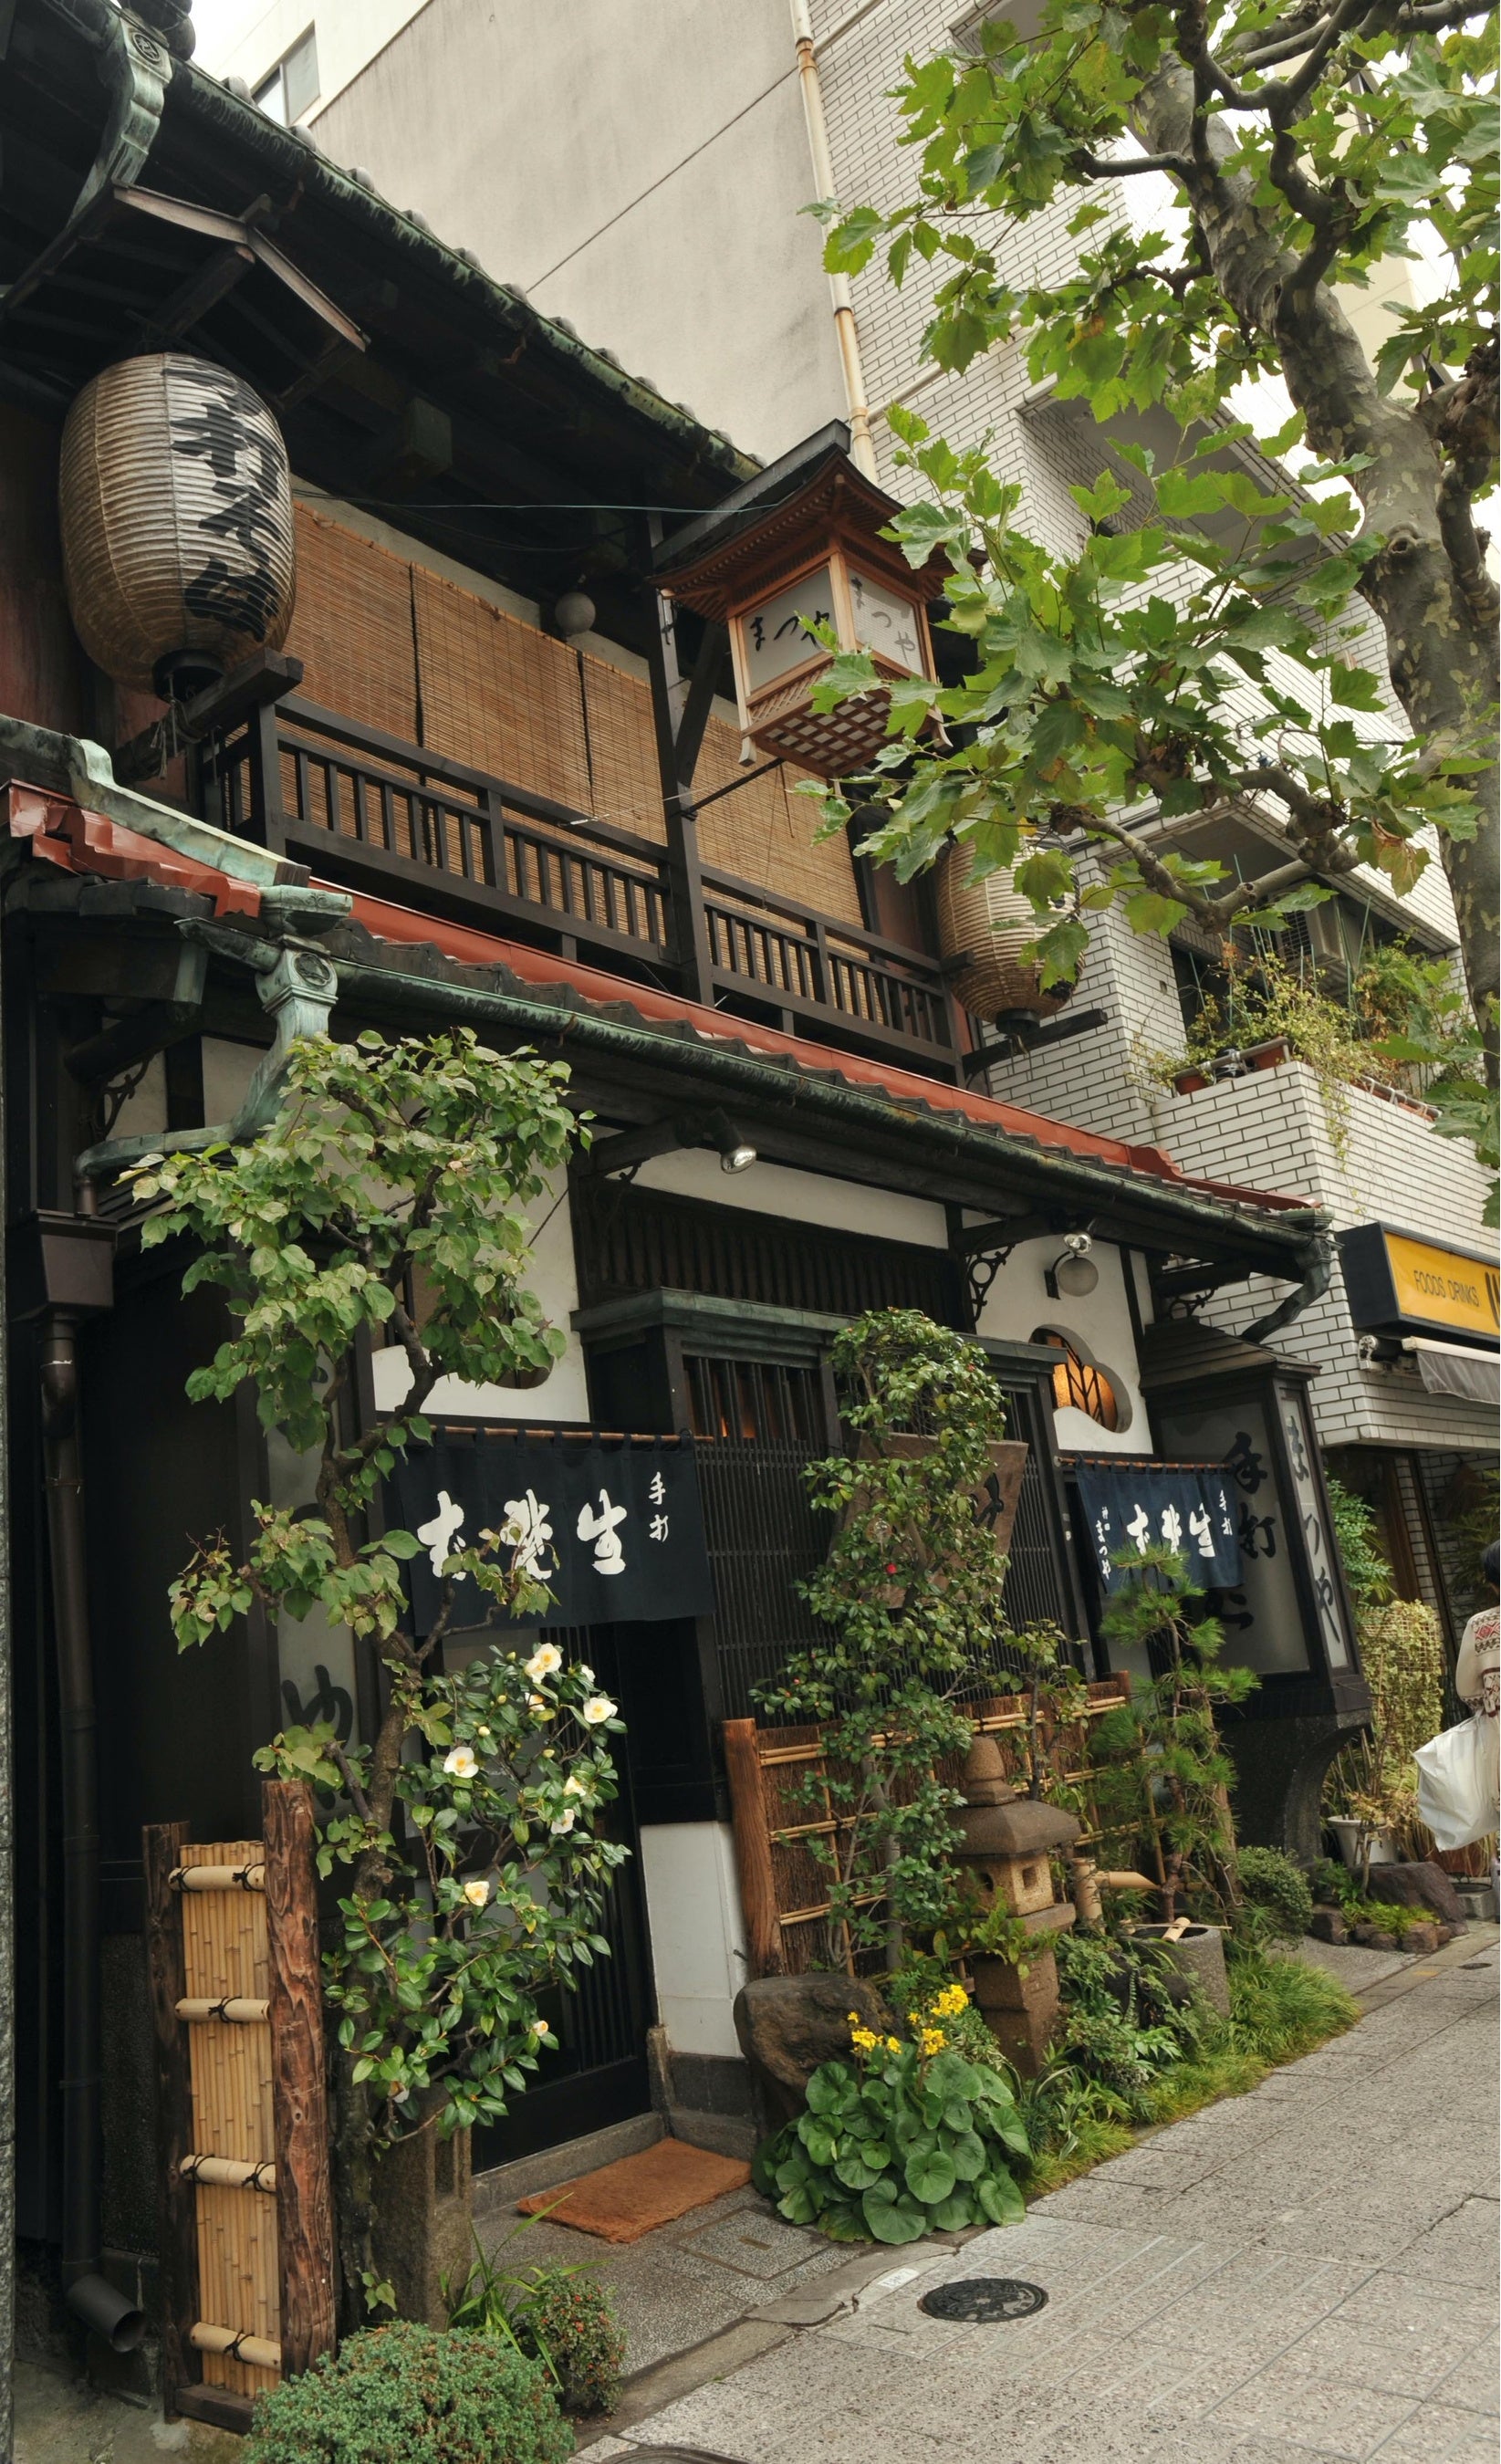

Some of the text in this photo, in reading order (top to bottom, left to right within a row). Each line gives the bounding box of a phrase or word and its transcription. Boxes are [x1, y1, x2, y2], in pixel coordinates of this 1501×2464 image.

[851, 577, 916, 665] まつや
[1413, 1270, 1446, 1298] FOODS
[1448, 1280, 1479, 1307] DRINKS
[648, 1472, 669, 1541] 手打
[1218, 1489, 1234, 1536] 手打
[1095, 1519, 1111, 1581] まつや
